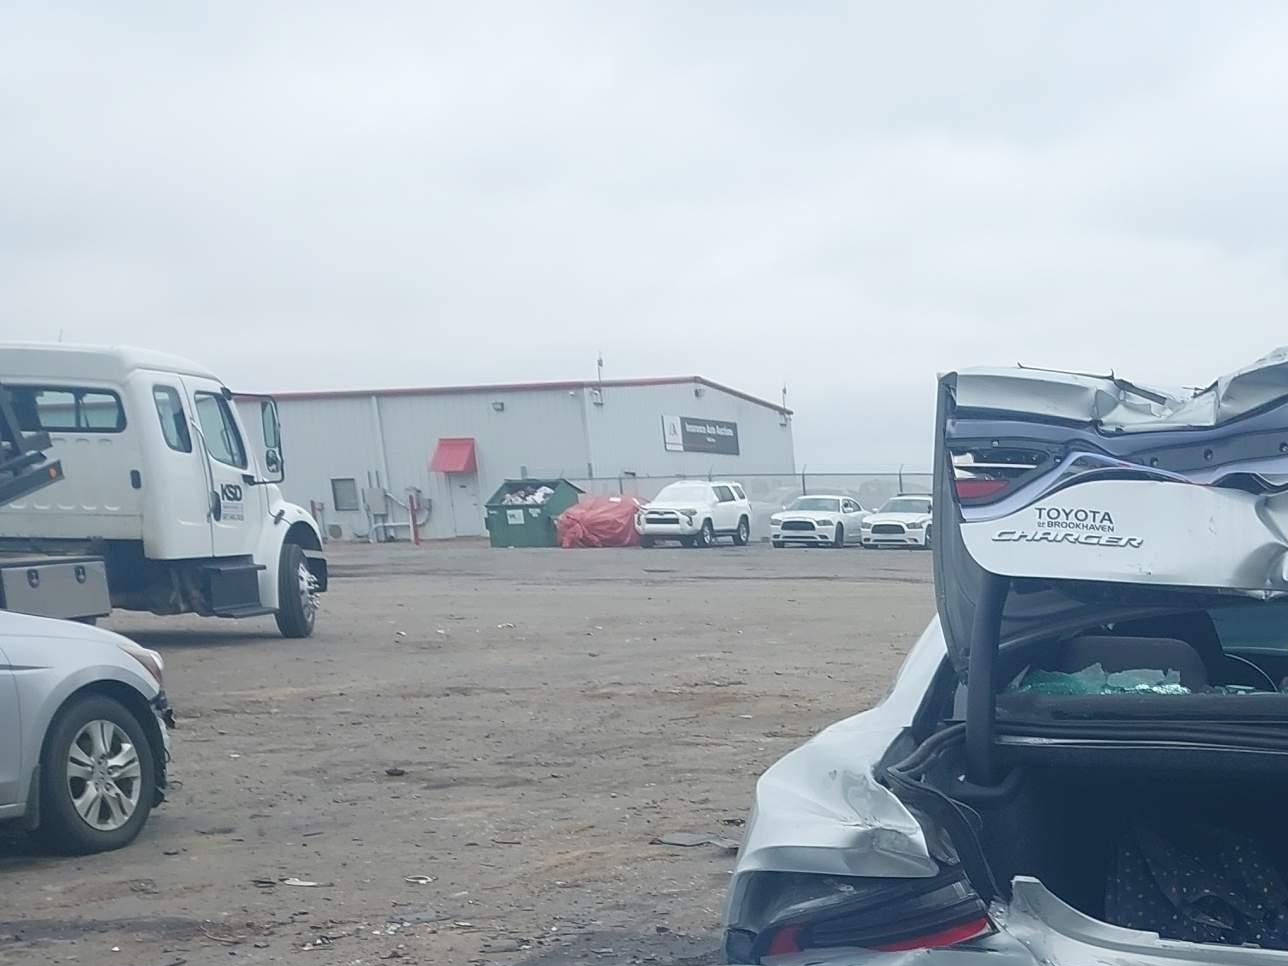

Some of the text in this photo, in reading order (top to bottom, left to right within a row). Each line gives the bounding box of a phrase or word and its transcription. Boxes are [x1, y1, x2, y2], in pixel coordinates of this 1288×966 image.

[220, 483, 242, 502] KSD
[1034, 507, 1113, 525] TOYOTA
[1047, 520, 1115, 533] BROOKHAVEN
[992, 530, 1144, 548] CHARGER
